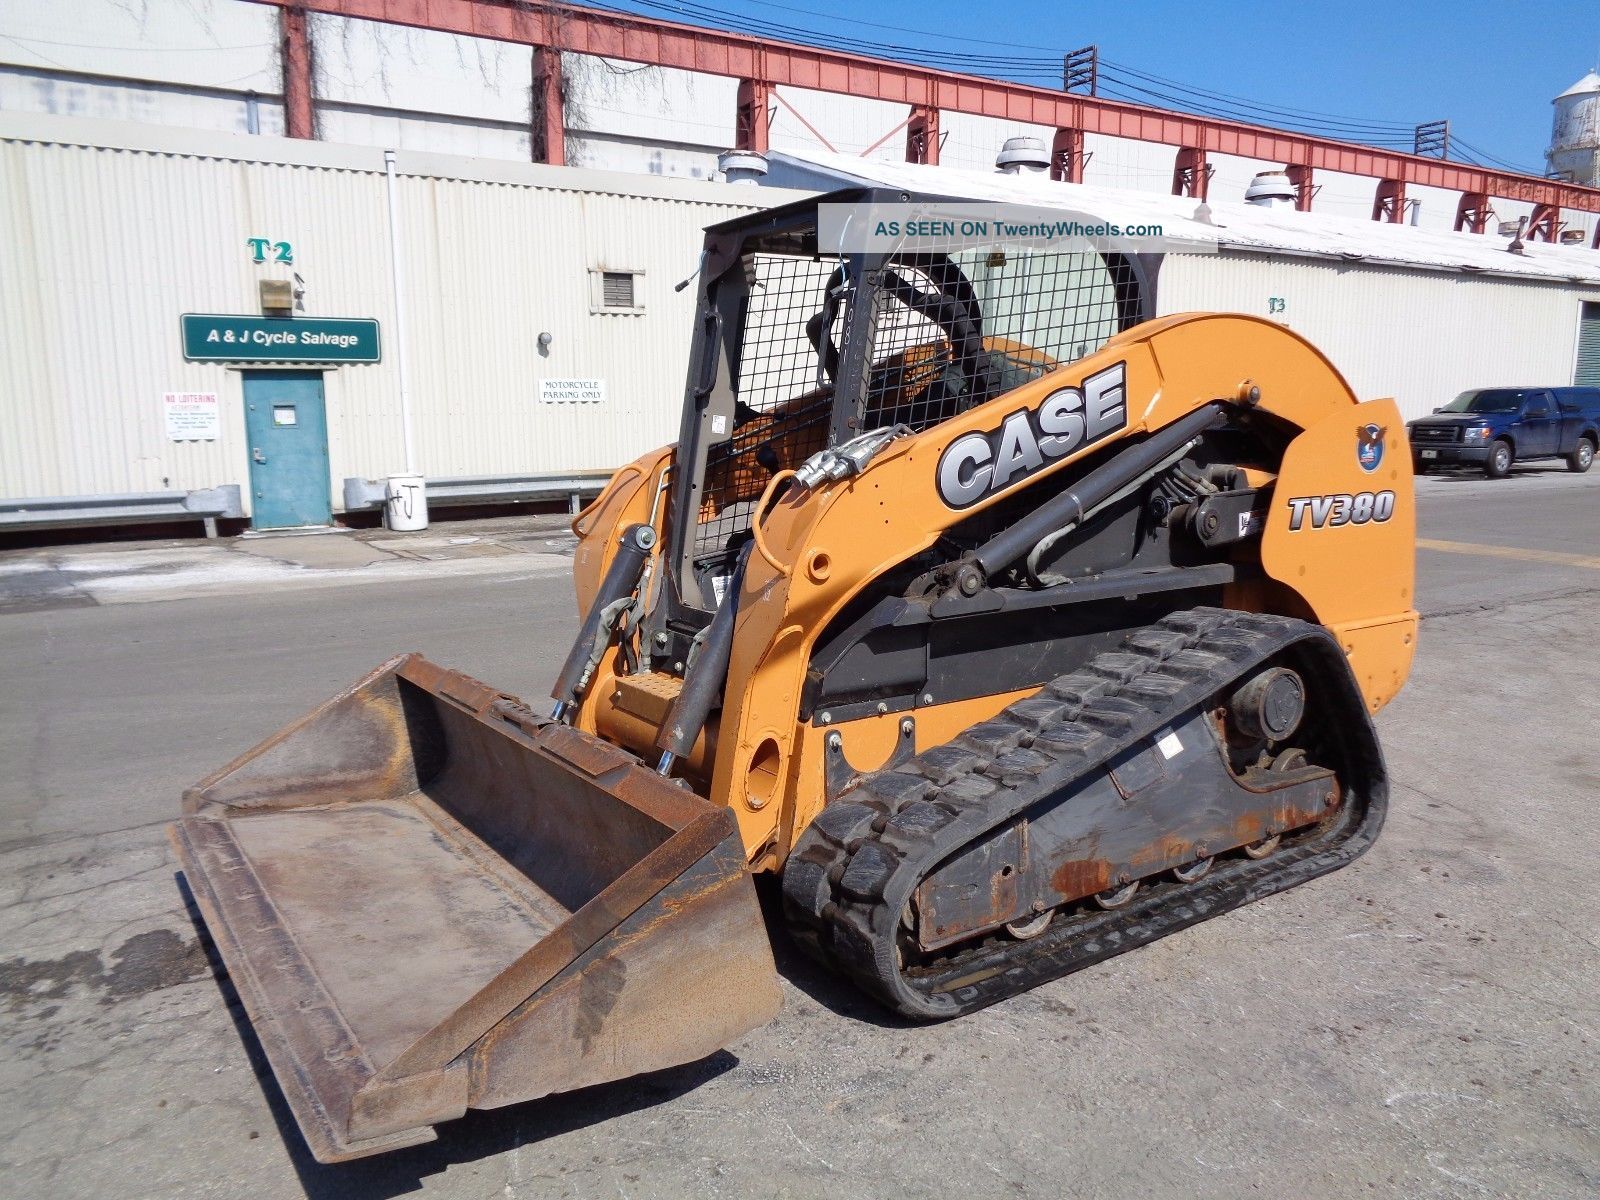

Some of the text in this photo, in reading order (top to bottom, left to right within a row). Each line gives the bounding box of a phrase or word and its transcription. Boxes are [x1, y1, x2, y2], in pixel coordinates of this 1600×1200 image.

[247, 237, 294, 263] T2
[1268, 297, 1286, 312] T3
[206, 329, 359, 348] A & J Cycle Salvage
[545, 381, 599, 389] MOTORCYCLE
[165, 394, 216, 403] NO LOITERING
[543, 391, 601, 399] PARKING ONLY
[936, 361, 1127, 510] CASE
[1287, 490, 1396, 532] TV380
